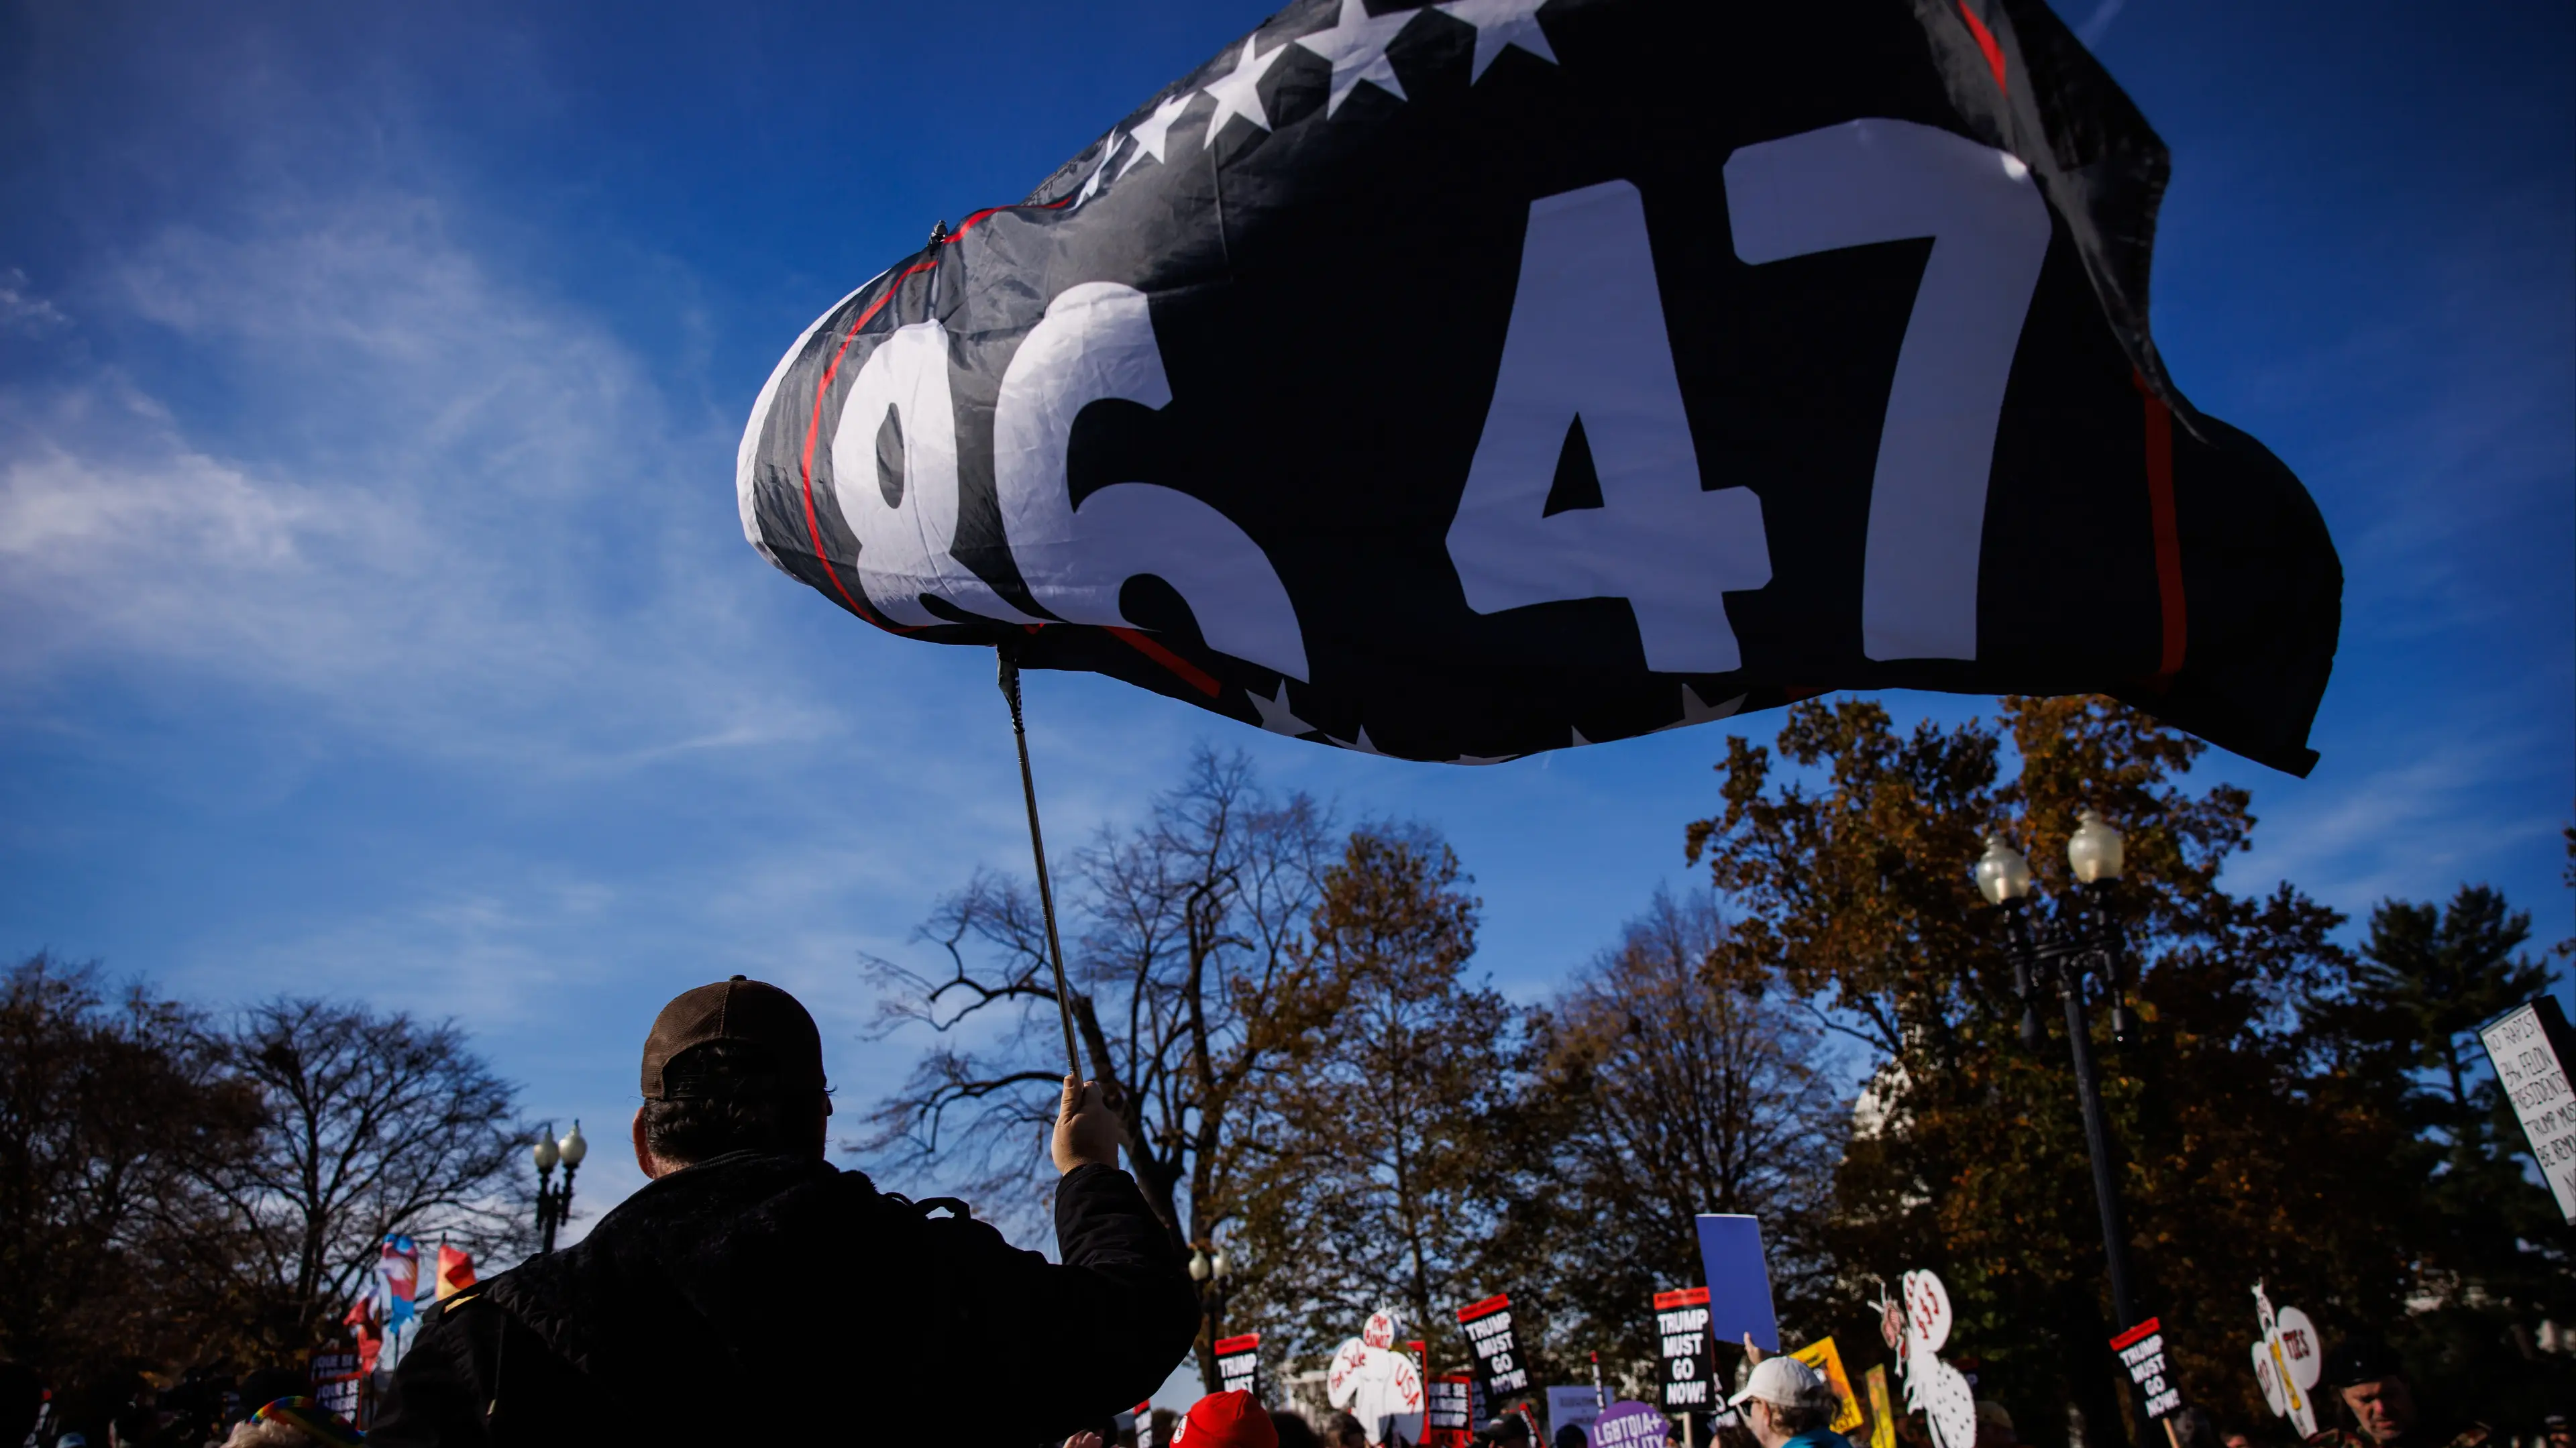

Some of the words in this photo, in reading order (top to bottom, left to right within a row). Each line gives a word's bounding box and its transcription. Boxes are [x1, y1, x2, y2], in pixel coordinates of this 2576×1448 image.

[832, 280, 1309, 685] 86
[1444, 117, 2053, 674] 47
[2518, 1044, 2555, 1078] FELON
[2523, 1111, 2558, 1140] TRUMP
[1464, 1311, 1512, 1342] TRUMP
[1656, 1308, 1709, 1335] TRUMP
[1475, 1331, 1515, 1360] MUST
[1662, 1332, 1705, 1358] MUST
[2118, 1333, 2164, 1368] TRUMP
[1218, 1353, 1257, 1379] TRUMP
[1491, 1353, 1514, 1374] GO
[1672, 1357, 1695, 1380] GO
[2129, 1353, 2167, 1384] MUST
[1395, 1363, 1420, 1415] USA
[1489, 1368, 1528, 1396] NOW!
[1666, 1380, 1707, 1405] NOW!
[2144, 1375, 2166, 1397] GO
[2145, 1387, 2182, 1418] NOW!
[1593, 1411, 1662, 1447] LGBTQIA+
